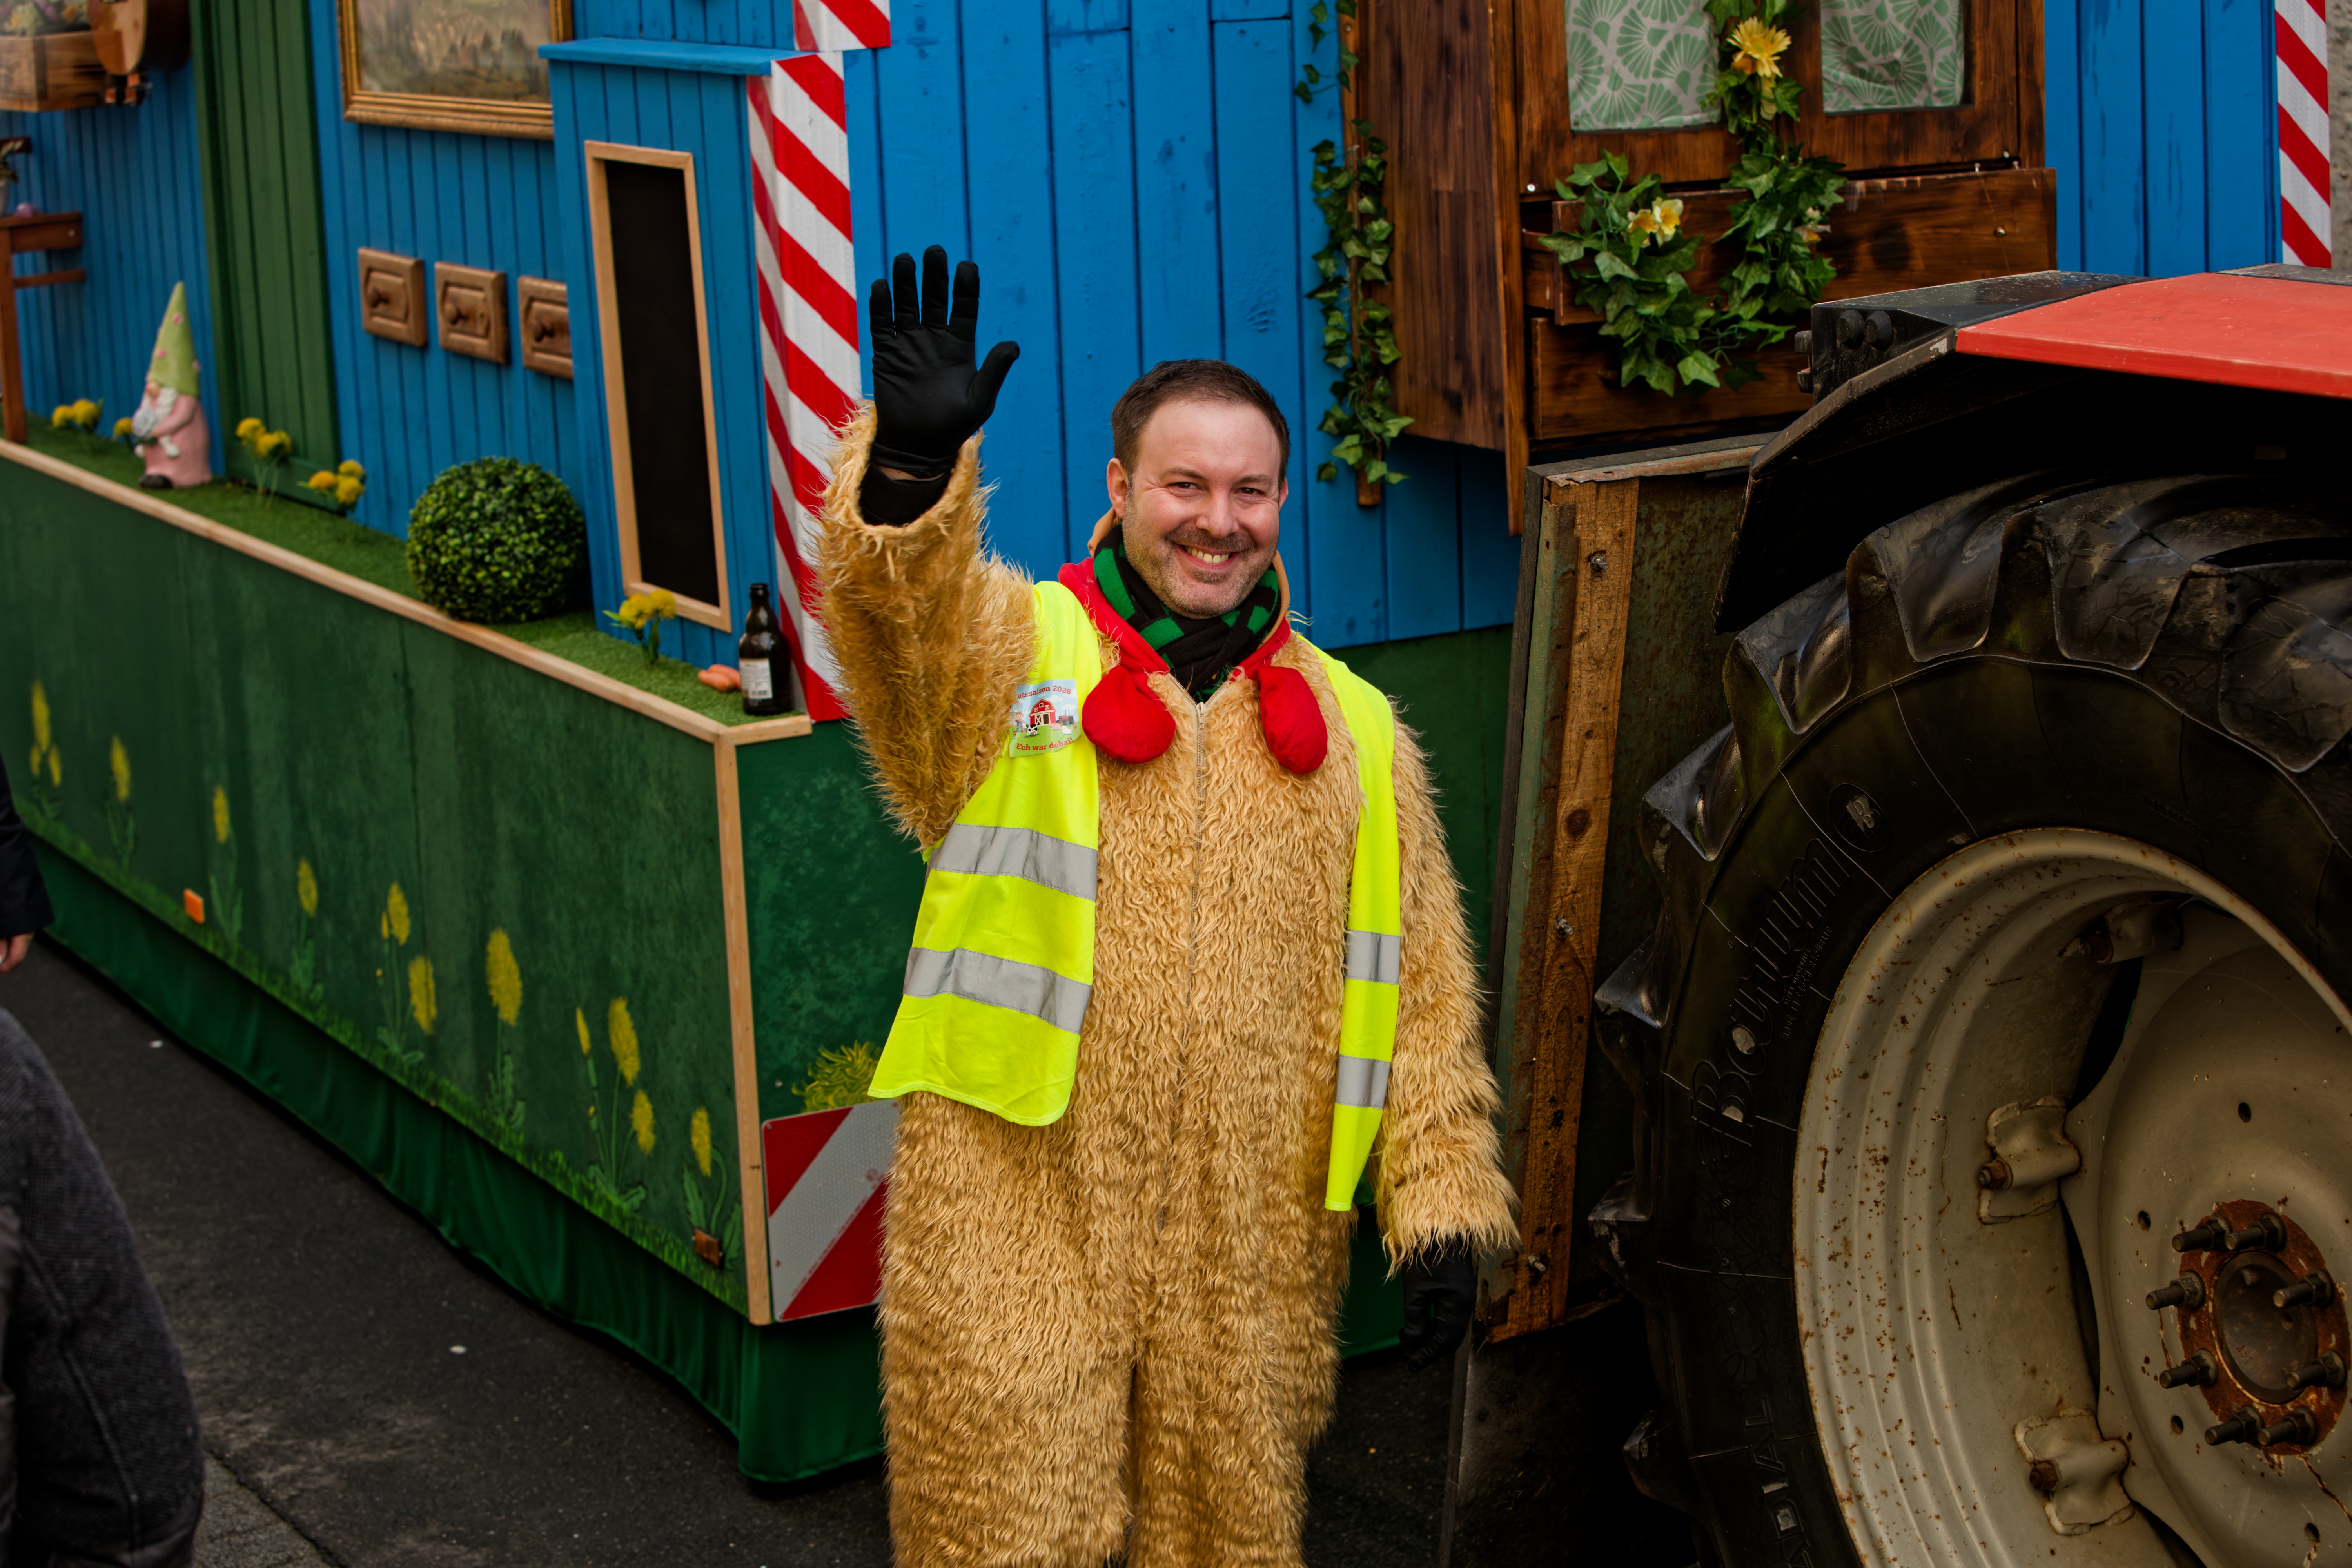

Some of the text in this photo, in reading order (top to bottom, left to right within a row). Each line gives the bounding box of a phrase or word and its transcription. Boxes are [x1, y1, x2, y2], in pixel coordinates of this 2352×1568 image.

[1018, 685, 1071, 699] uessaison 2026
[1690, 838, 1850, 1148] Barum
[1781, 926, 1834, 1041] MADE IN CZECH REPUBLIC
